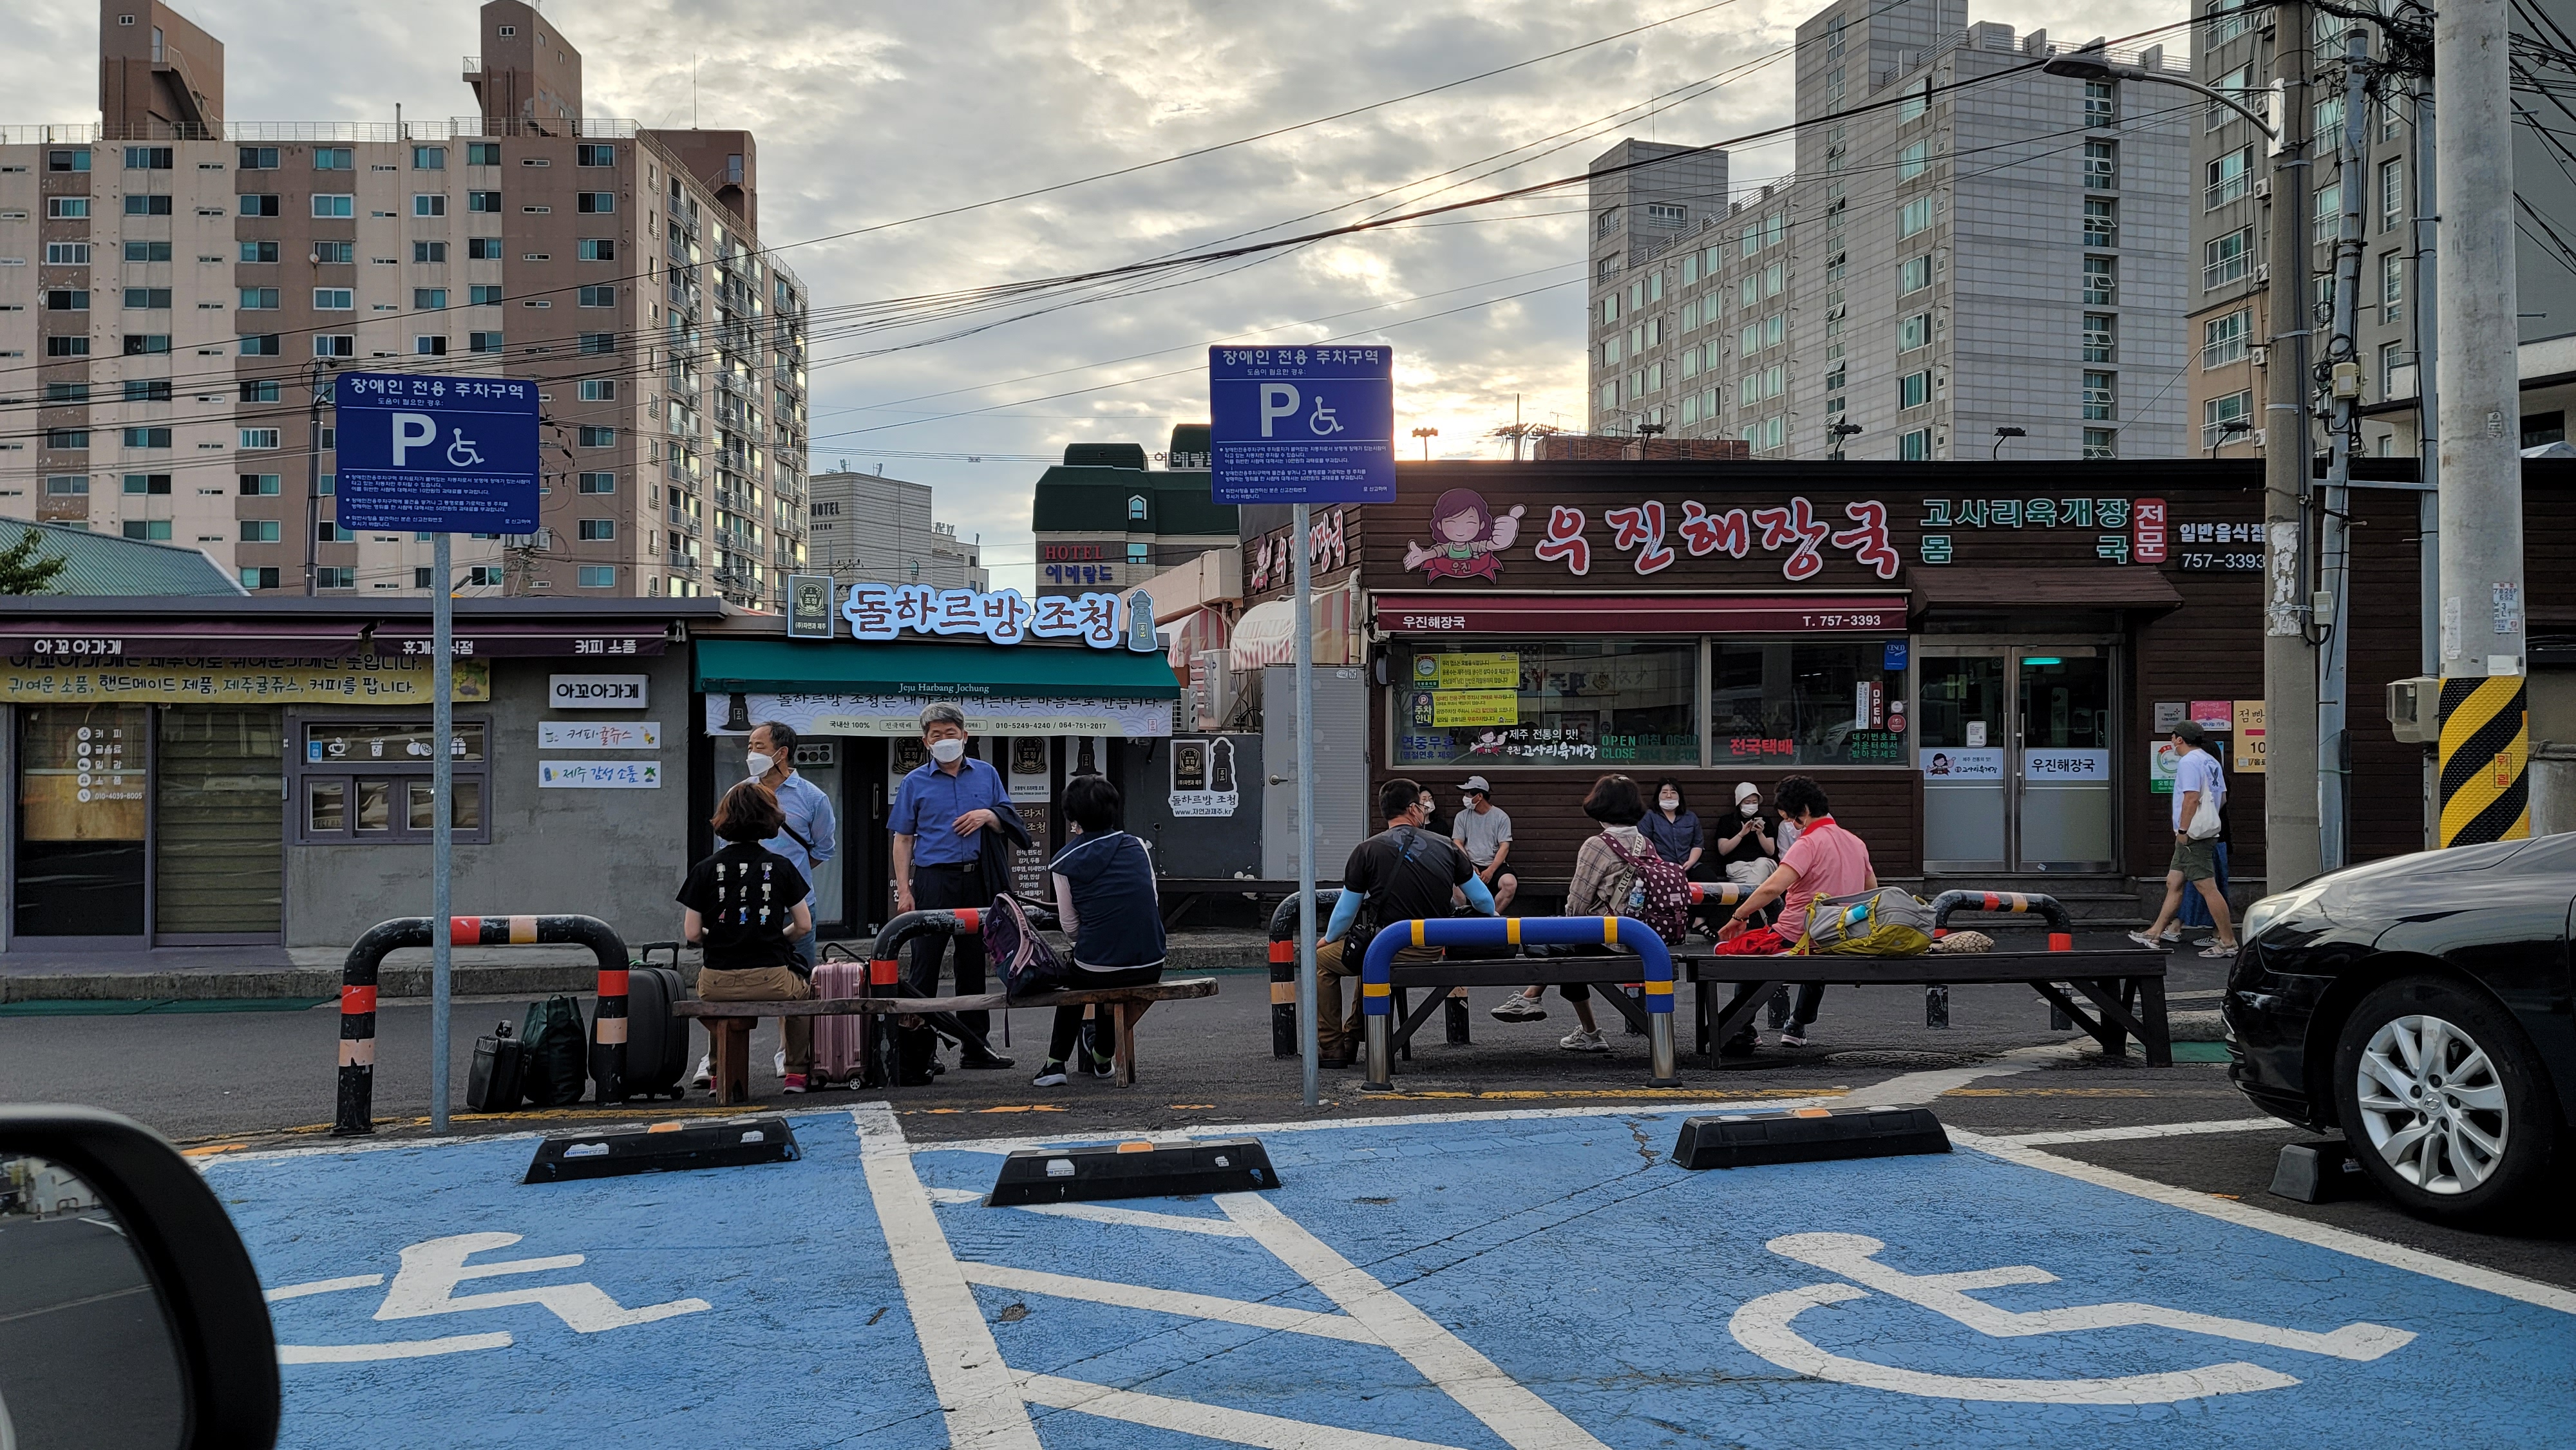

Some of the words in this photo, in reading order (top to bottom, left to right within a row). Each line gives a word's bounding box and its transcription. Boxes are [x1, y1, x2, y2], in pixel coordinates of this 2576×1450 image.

[1223, 350, 1269, 366] 장애인
[1278, 350, 1308, 366] 전용
[1316, 350, 1378, 365] 주차구역
[351, 378, 403, 395] 장애인
[412, 380, 446, 397] 전용
[455, 382, 524, 399] 주차구역
[1260, 383, 1300, 437] P
[392, 413, 437, 466] P
[811, 502, 840, 516] HOTEL
[1920, 498, 2130, 528] 고사리육개장
[2136, 504, 2164, 558] 전문
[1276, 509, 1346, 583] 우장국
[1535, 496, 1900, 581] 우진해장국
[1045, 545, 1104, 560] HOTEL
[1451, 561, 1472, 574] 우진
[2182, 553, 2266, 569] 757-3393
[1045, 564, 1113, 584] 에메랄드
[849, 590, 1023, 637] 돌하르방
[1038, 599, 1114, 641] 조청
[1403, 616, 1466, 629] 우진해장국
[1803, 616, 1816, 626] T.
[1820, 615, 1881, 626] 757-3393
[34, 639, 122, 655] 아꼬아가게
[402, 641, 474, 655] 휴게식점
[575, 639, 603, 654] 커피
[607, 639, 637, 654] 소품
[8, 675, 55, 693] 귀여운
[60, 675, 95, 693] 소품,
[99, 673, 176, 692] 핸드메이드
[182, 675, 218, 695] 제품,
[223, 676, 305, 694] 제주귤쥬스,
[309, 676, 358, 695] 커피를
[363, 676, 416, 695] 팝니다.
[556, 684, 639, 699] 아꼬아가게
[898, 683, 916, 694] Jeju
[918, 683, 954, 695] Harbang
[956, 684, 990, 695] Jochung
[776, 693, 842, 708] 돌하르방
[849, 693, 897, 708] 조청은
[1102, 697, 1163, 711] 만듭니다.
[1415, 705, 1432, 715] 주차
[829, 720, 849, 729] 국내산
[1415, 714, 1432, 724] 안내
[1509, 729, 1529, 740] 제주
[1533, 729, 1562, 740] 전통의
[1566, 728, 1578, 740] 맛!
[1601, 735, 1636, 746] OPEN
[1401, 735, 1455, 750] 연중무휴
[1730, 739, 1794, 755] 전국택배
[1852, 741, 1898, 750] 카운터에서
[1506, 746, 1521, 756] 우진
[1521, 742, 1597, 760] 고사리육개장
[1601, 748, 1636, 759] CLOSE
[1852, 749, 1898, 758] 받아주세요
[2031, 758, 2096, 773] 우진해장국
[563, 766, 587, 783] 제주
[591, 766, 614, 781] 감성
[617, 765, 639, 783] 소품
[1171, 795, 1213, 806] 돌하르방
[1216, 795, 1236, 805] 조청
[1026, 822, 1046, 834] 조청
[1634, 835, 1643, 857] RTHA
[1618, 868, 1633, 893] ALICE
